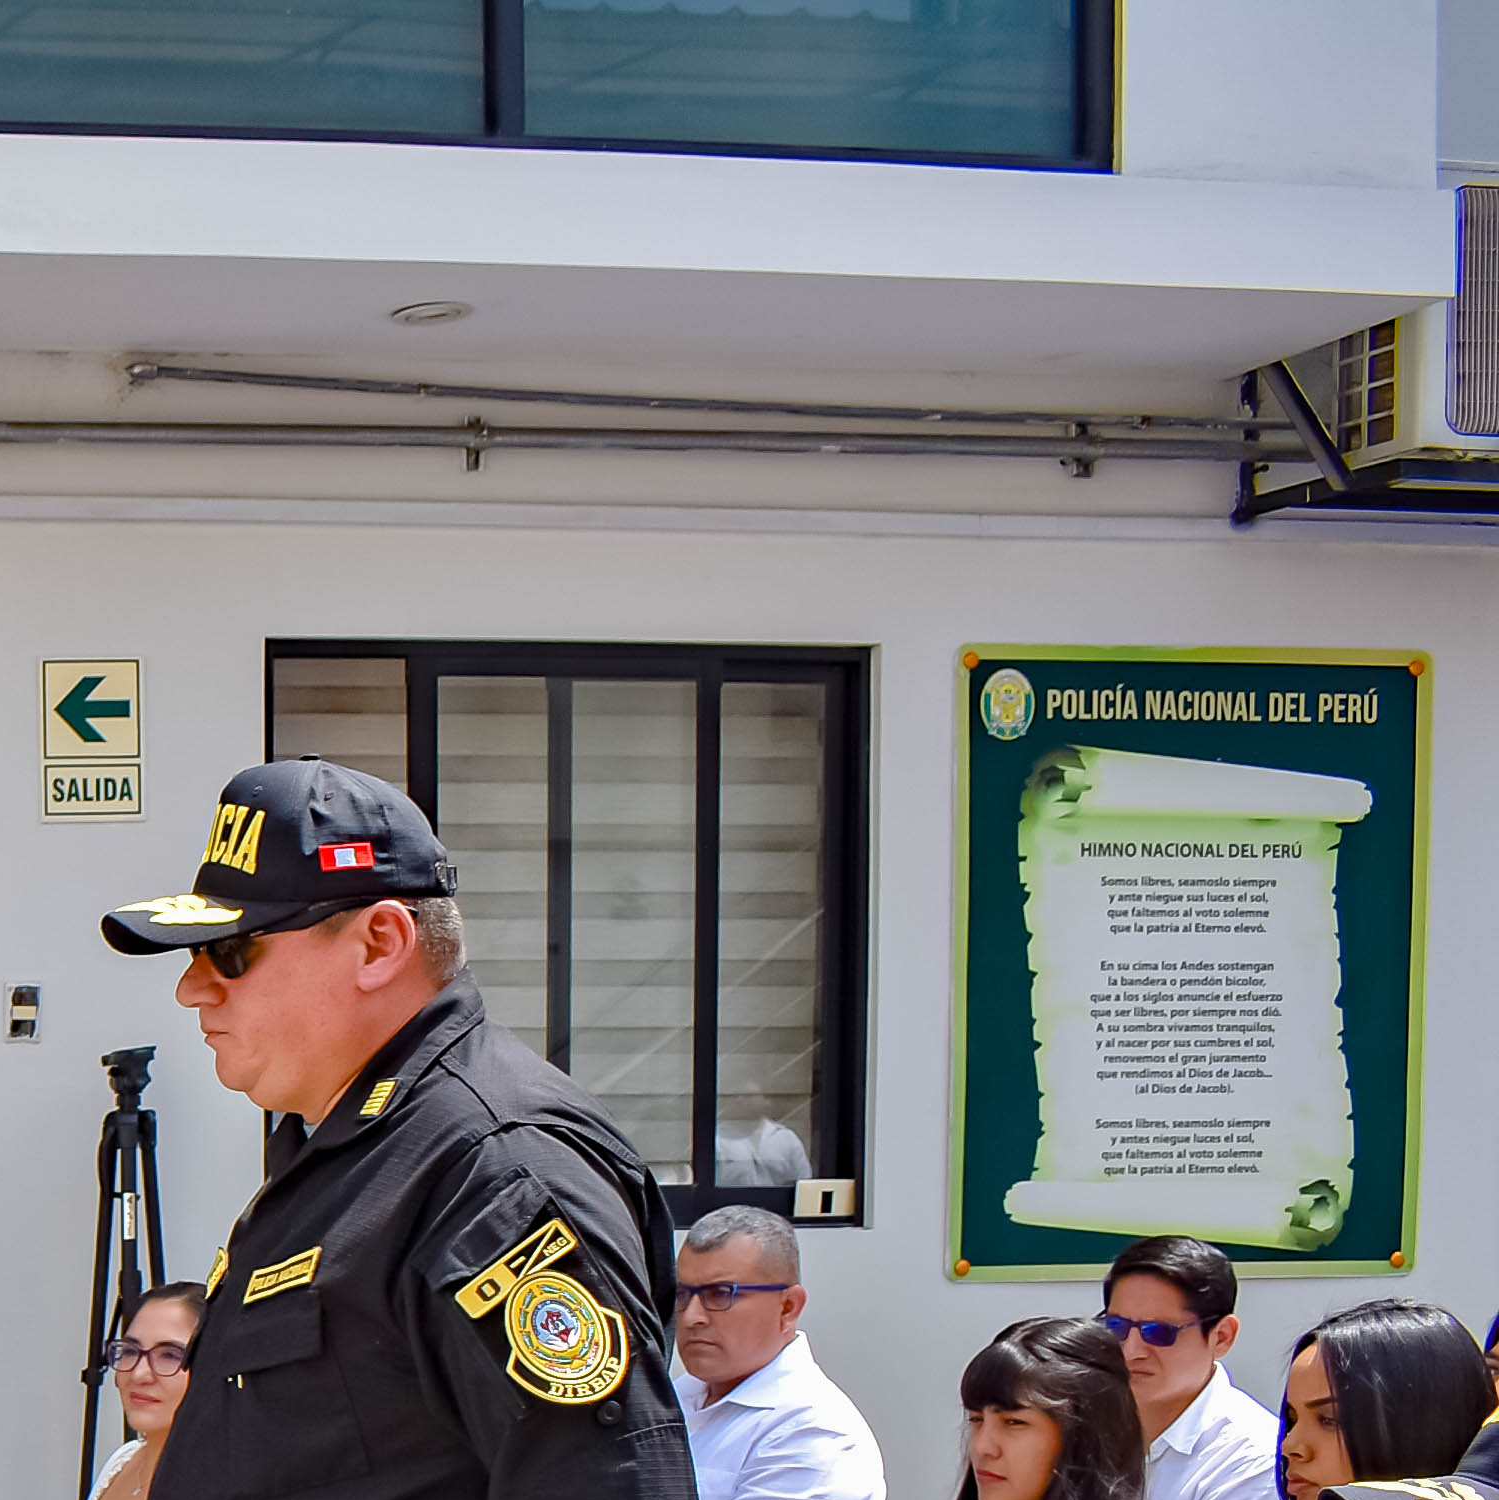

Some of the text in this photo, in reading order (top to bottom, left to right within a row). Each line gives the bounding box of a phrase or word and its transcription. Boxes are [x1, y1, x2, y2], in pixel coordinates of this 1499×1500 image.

[1046, 683, 1379, 724] POLICÍA NACIONAL DEL PERÚ
[52, 777, 133, 803] SALIDA
[1080, 842, 1302, 858] HIMNO NACIONAL DEL PERÚ
[1101, 876, 1138, 887] Somos
[1178, 877, 1230, 888] seamoslo
[1233, 877, 1277, 889] siempre
[1108, 895, 1115, 905] y
[1118, 893, 1142, 903] ante
[1145, 892, 1184, 905] niegue
[1186, 894, 1203, 903] sus
[1207, 892, 1234, 903] luces
[1238, 892, 1247, 903] el
[1107, 910, 1128, 920] que
[1183, 907, 1192, 918] al
[1195, 909, 1220, 918] voto
[1223, 908, 1269, 919] solemne
[1110, 925, 1131, 936] que
[1134, 922, 1143, 933] la
[1146, 923, 1179, 936] patria
[1182, 923, 1191, 933] al
[1195, 923, 1231, 934] Eterno
[1100, 960, 1274, 974] En su cima los Andes sostengan
[1108, 976, 1117, 987] la
[1120, 976, 1167, 987] bandera
[1170, 978, 1177, 987] o
[1179, 976, 1223, 989] pendón
[1090, 991, 1283, 1005] que a los siglos anuncie el esfuerzo
[1090, 1010, 1111, 1020] que
[1115, 1010, 1131, 1018] ser
[1170, 1009, 1190, 1020] por
[1193, 1007, 1236, 1020] siempre
[1239, 1009, 1259, 1018] nos
[1096, 1023, 1104, 1033] A
[1107, 1025, 1120, 1033] su
[1123, 1022, 1165, 1033] sombra
[1167, 1023, 1213, 1033] vivamos
[1095, 1041, 1102, 1051] y
[1105, 1038, 1115, 1049] al
[1118, 1040, 1148, 1049] nacer
[1151, 1040, 1171, 1051] por
[1173, 1040, 1191, 1049] sus
[1194, 1038, 1241, 1048] cumbres
[1244, 1038, 1253, 1048] el
[1103, 1053, 1266, 1067] renovemos el gran juramento
[1096, 1071, 1118, 1082] que
[1120, 1068, 1173, 1079] rendimos
[1176, 1068, 1185, 1079] al
[1189, 1068, 1213, 1079] Dios
[1216, 1068, 1229, 1079] de
[1135, 1083, 1149, 1096] (al
[1152, 1084, 1176, 1095] Dios
[1179, 1084, 1192, 1094] de
[1095, 1119, 1133, 1130] Somos
[1172, 1118, 1224, 1129] seamoslo
[1227, 1118, 1271, 1131] siempre
[1111, 1137, 1117, 1147] y
[1119, 1136, 1150, 1145] antes
[1153, 1134, 1190, 1147] niegue
[1193, 1133, 1221, 1144] luces
[1224, 1133, 1233, 1144] el
[1101, 1152, 1123, 1162] que
[1177, 1149, 1186, 1159] al
[1189, 1150, 1214, 1159] voto
[1217, 1149, 1263, 1159] solemne
[1104, 1167, 1125, 1178] que
[1128, 1164, 1137, 1175] la
[1140, 1164, 1173, 1177] patria
[1176, 1164, 1185, 1175] al
[1189, 1164, 1225, 1175] Eterno
[543, 1236, 569, 1257] NEG
[547, 1356, 621, 1398] DIRBAP
